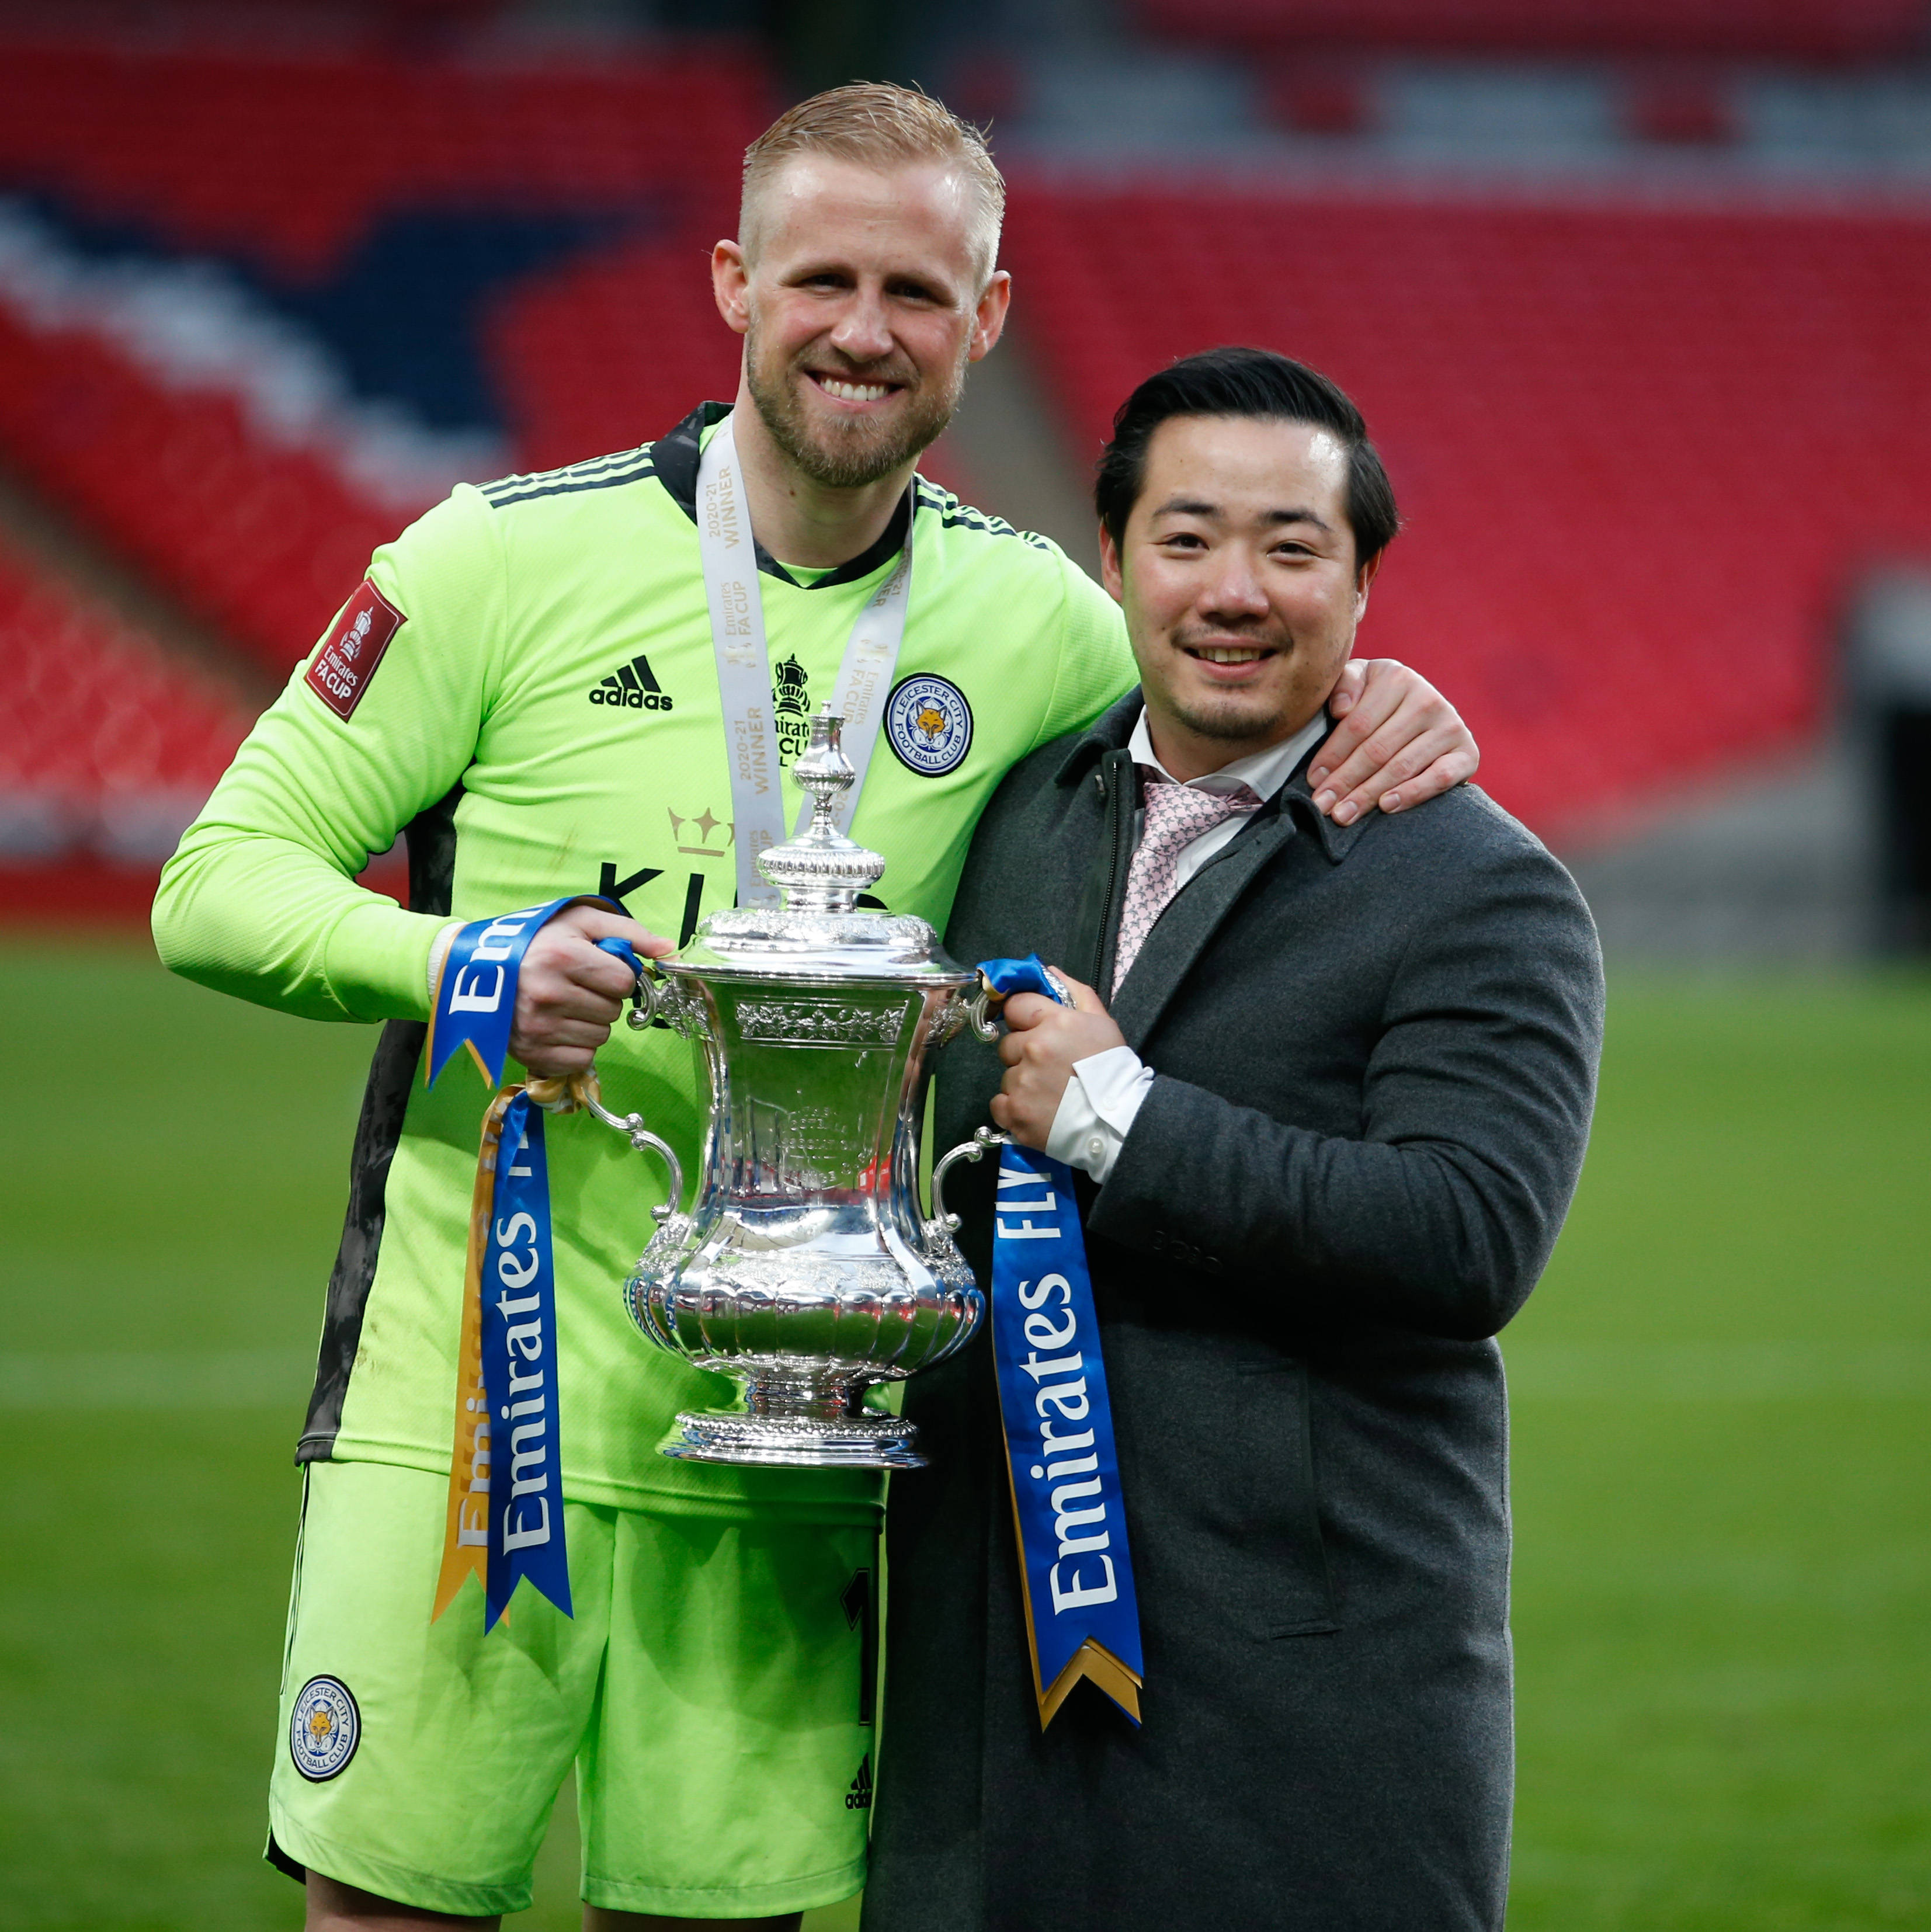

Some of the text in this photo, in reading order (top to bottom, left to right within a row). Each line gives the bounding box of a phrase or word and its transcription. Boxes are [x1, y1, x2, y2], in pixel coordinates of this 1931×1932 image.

[706, 482, 721, 538] 2020-21
[718, 465, 740, 550] WINNER
[721, 582, 737, 635] Emirates
[732, 581, 752, 635] FA CUP
[324, 645, 359, 686] Emirates
[589, 686, 673, 711] adidas
[841, 669, 866, 724] FA CUP
[855, 672, 879, 725] Emirates
[896, 684, 963, 728] LEICESTER CITY
[734, 720, 751, 781] 2020-21
[748, 707, 770, 795] WINNER
[895, 723, 961, 764] FOOTBALL CLUB
[994, 1167, 1061, 1239] FLY
[495, 1211, 551, 1556] Emirates
[1018, 1273, 1117, 1615] Emirates
[840, 1568, 870, 1726] 1
[297, 1687, 349, 1726] LEICESTER CITY
[296, 1731, 348, 1768] FOOTBALL CLUB
